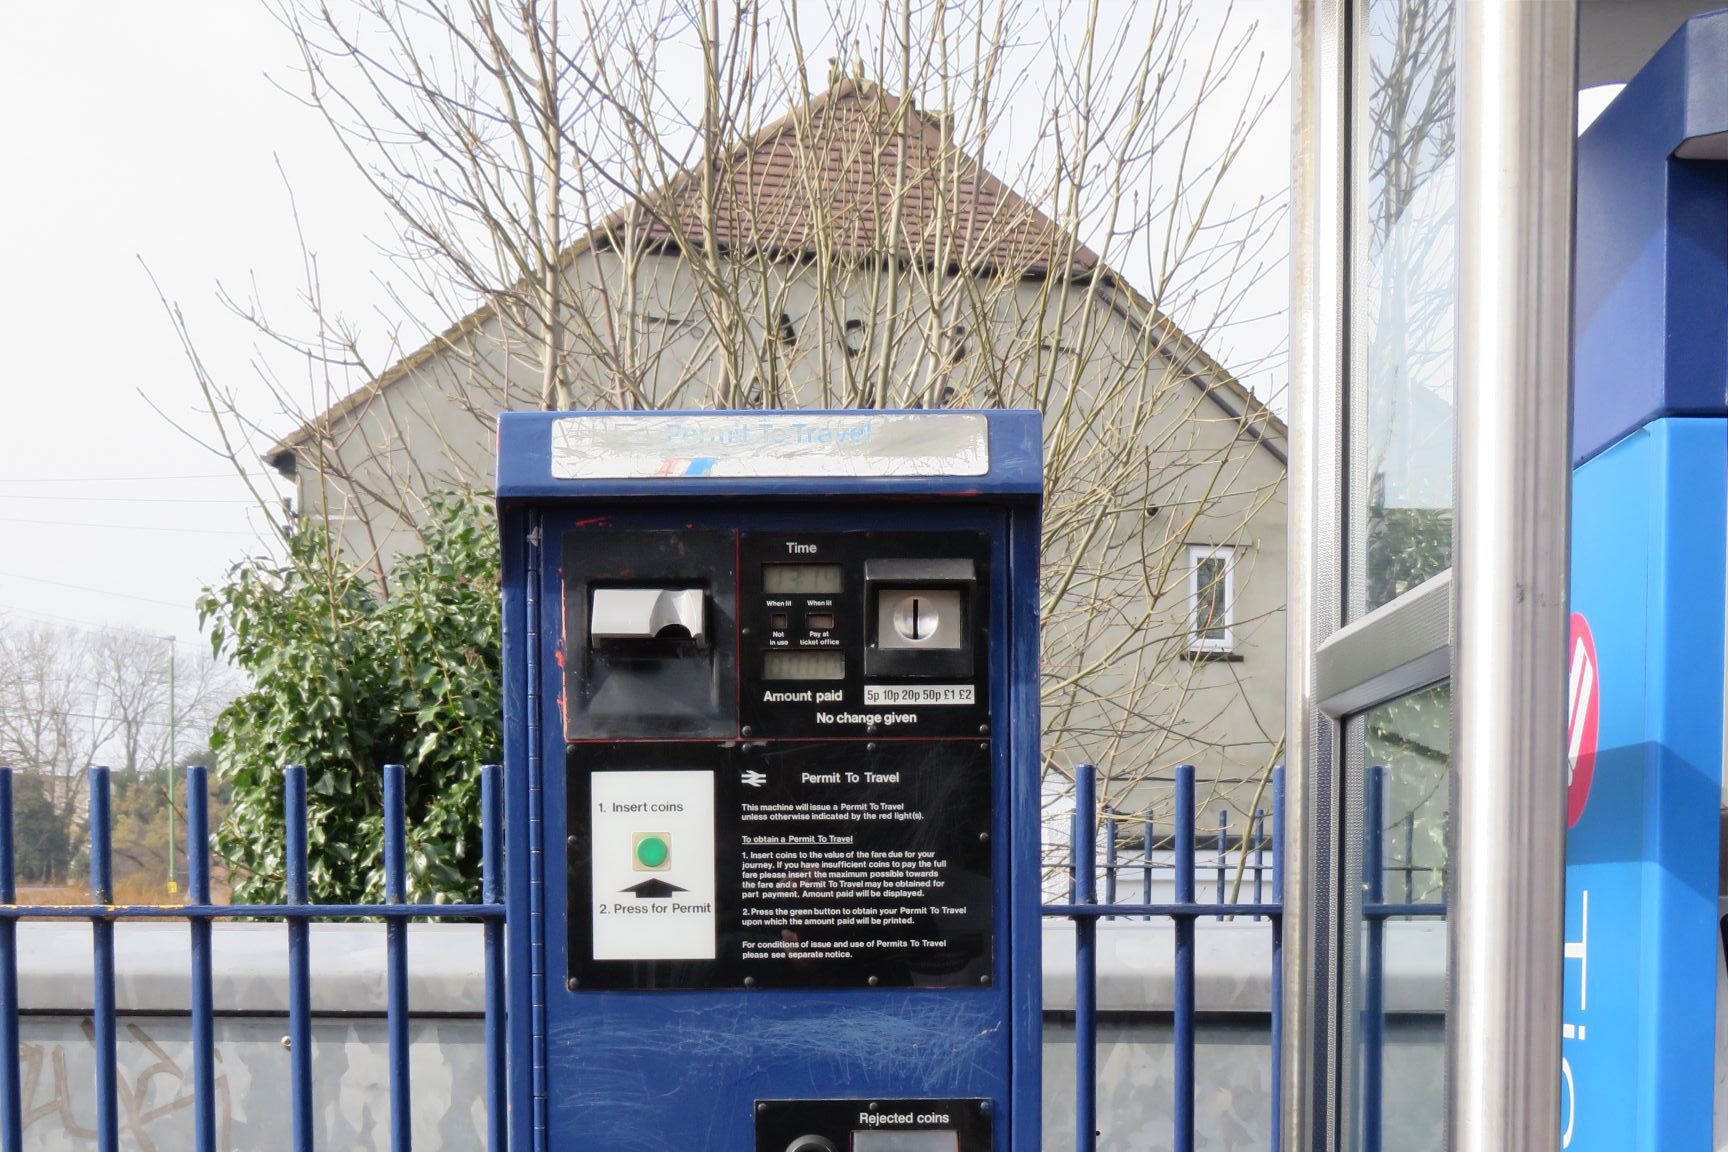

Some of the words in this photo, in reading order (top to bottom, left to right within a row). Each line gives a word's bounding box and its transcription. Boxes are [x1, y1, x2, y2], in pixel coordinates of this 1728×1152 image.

[791, 421, 873, 444] Travel
[786, 542, 817, 554] Time
[809, 630, 822, 639] Pay
[763, 690, 812, 702] Amount
[816, 689, 843, 704] paid
[867, 690, 880, 703] 5p
[883, 689, 900, 703] 10p
[901, 689, 921, 703] 20p
[922, 689, 942, 702] 50p
[944, 689, 955, 700] £1
[958, 689, 972, 700] £2
[816, 712, 835, 724] No
[836, 712, 882, 726] change
[883, 711, 917, 726] given
[802, 772, 841, 784] Permit
[844, 772, 860, 783] To
[864, 771, 900, 783] Travel
[598, 802, 606, 813] 1.
[612, 802, 648, 813] Insert
[650, 802, 684, 812] coins
[741, 803, 759, 811] This
[760, 803, 794, 811] machine
[795, 803, 809, 811] will
[809, 803, 831, 811] issue
[840, 803, 868, 811] Permit
[869, 802, 880, 811] To
[879, 802, 904, 811] Travel
[741, 813, 768, 821] unless
[769, 812, 811, 821] otherwise
[811, 812, 849, 820] indicated
[851, 812, 861, 821] by
[863, 812, 877, 820] the
[878, 812, 893, 820] red
[894, 811, 924, 821] light(s).
[741, 835, 752, 843] To
[753, 835, 779, 843] obtain
[788, 835, 815, 843] Permit
[817, 834, 827, 843] To
[829, 835, 853, 843] Travel
[750, 851, 774, 859] Insert
[775, 851, 798, 859] coins
[799, 851, 808, 859] to
[809, 851, 823, 859] the
[823, 850, 845, 859] value
[845, 850, 854, 859] of
[856, 850, 870, 858] the
[870, 850, 887, 858] fare
[887, 850, 903, 858] due
[904, 850, 916, 858] for
[917, 851, 935, 859] your
[741, 861, 775, 870] journey.
[776, 861, 783, 869] If
[784, 862, 799, 870] you
[800, 860, 820, 869] have
[821, 860, 867, 869] insufficient
[868, 860, 890, 868] coins
[891, 860, 901, 868] to
[901, 861, 917, 869] pay
[918, 860, 932, 868] the
[933, 859, 947, 868] full
[742, 870, 758, 879] fare
[759, 870, 787, 880] please
[788, 870, 812, 879] insert
[813, 870, 828, 879] the
[828, 870, 868, 878] maximum
[869, 869, 904, 879] possible
[905, 869, 939, 878] towards
[742, 881, 756, 889] the
[757, 880, 774, 889] fare
[775, 880, 791, 889] and
[799, 880, 827, 888] Permit
[828, 880, 838, 888] To
[839, 880, 864, 888] Travel
[864, 881, 882, 889] may
[883, 880, 894, 888] be
[895, 879, 931, 888] obtained
[933, 879, 945, 887] for
[742, 891, 759, 899] part
[762, 890, 800, 899] payment.
[802, 890, 834, 898] Amount
[835, 889, 854, 899] paid
[855, 889, 870, 897] will
[870, 889, 882, 897] be
[882, 889, 925, 898] displayed.
[599, 903, 611, 914] 2.
[614, 903, 649, 914] Press
[651, 903, 668, 914] for
[672, 903, 711, 914] Permit
[750, 907, 774, 916] Press
[775, 907, 789, 916] the
[789, 909, 813, 917] green
[813, 907, 841, 915] button
[842, 907, 851, 915] to
[851, 907, 878, 915] obtain
[879, 908, 898, 916] your
[900, 906, 927, 915] Permit
[929, 906, 940, 914] To
[941, 906, 967, 914] Travel
[741, 919, 763, 927] upon
[763, 917, 788, 926] which
[789, 917, 803, 925] the
[804, 917, 835, 925] amount
[837, 917, 855, 926] paid
[855, 917, 870, 925] will
[870, 917, 882, 925] be
[882, 916, 915, 926] printed.
[742, 940, 756, 949] For
[757, 940, 800, 949] conditions
[800, 940, 809, 948] of
[810, 940, 832, 948] issue
[833, 940, 849, 948] and
[866, 940, 875, 948] of
[876, 939, 908, 948] Permits
[909, 939, 920, 947] To
[921, 939, 947, 947] Travel
[742, 951, 769, 960] please
[788, 950, 824, 960] separate
[824, 950, 853, 958] notice.
[859, 1112, 914, 1127] Rejected
[917, 1111, 950, 1124] coins
